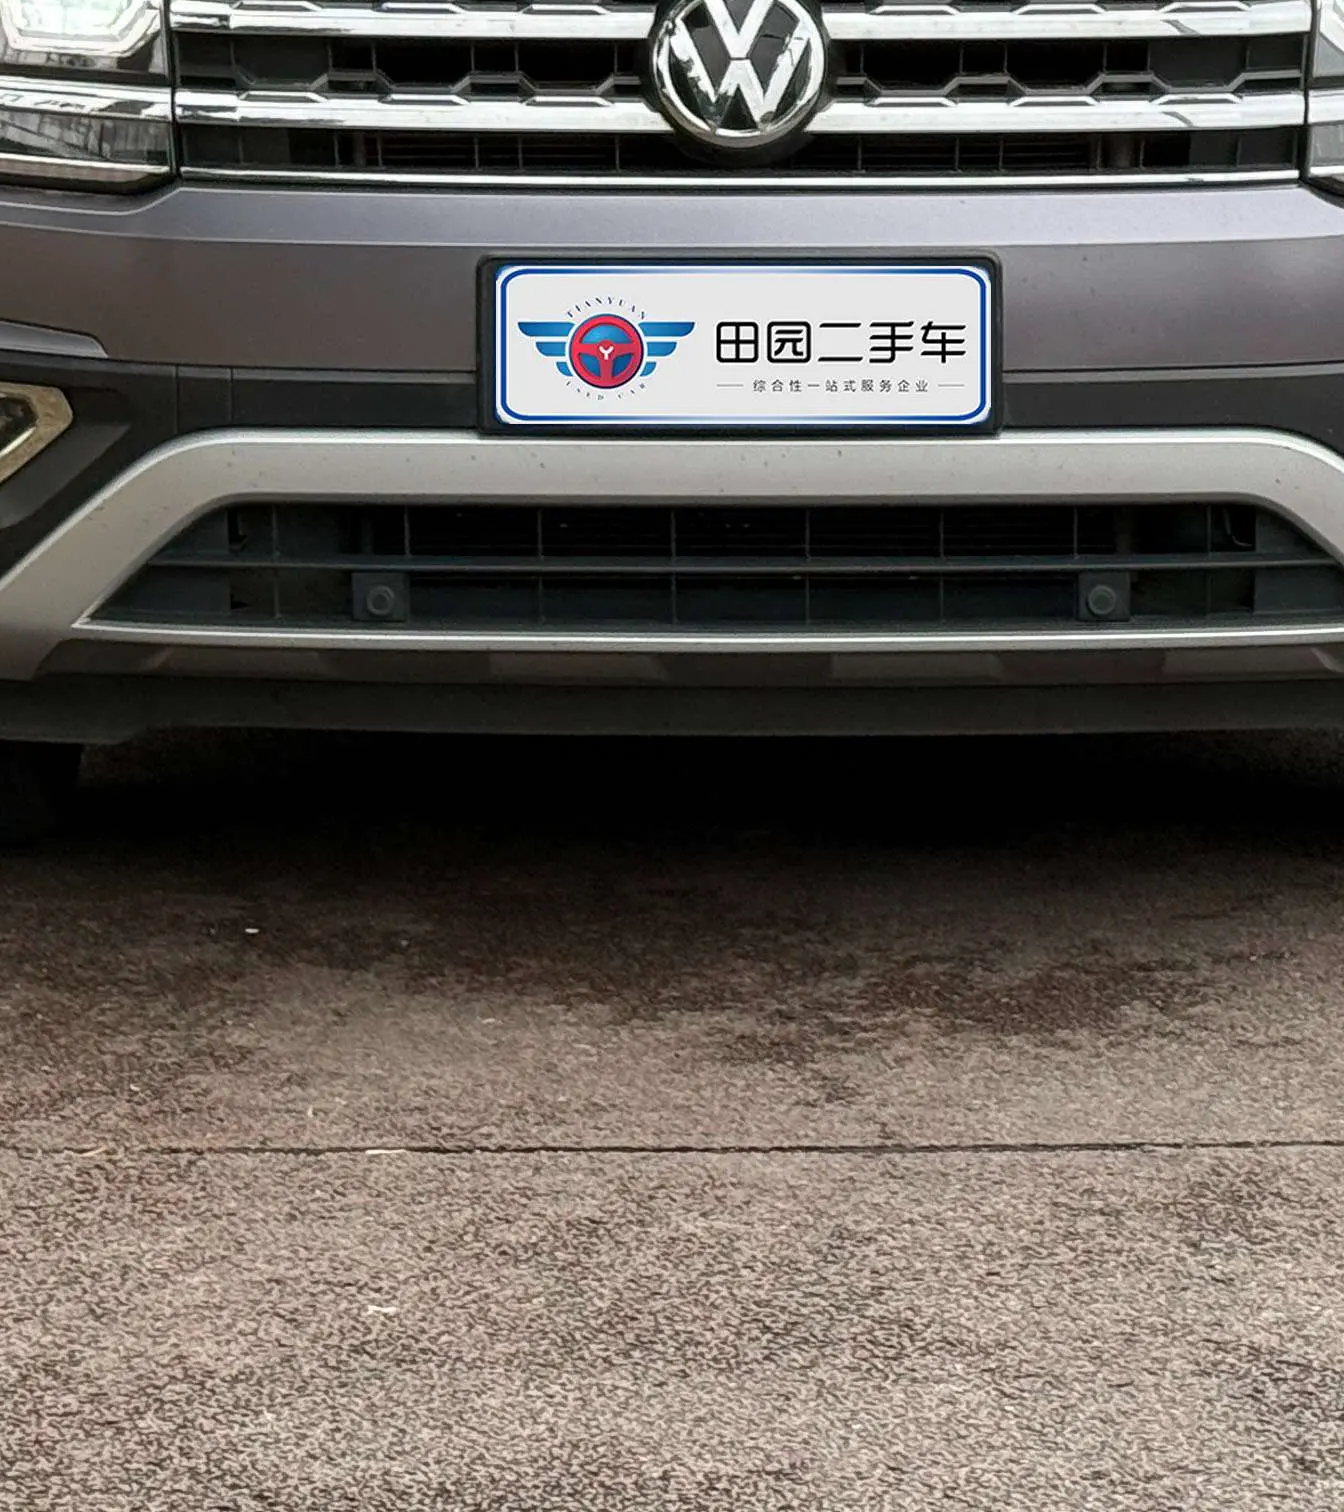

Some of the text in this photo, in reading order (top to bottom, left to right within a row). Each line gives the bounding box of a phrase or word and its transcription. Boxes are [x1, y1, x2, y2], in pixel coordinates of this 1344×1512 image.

[716, 321, 966, 364] 田园二手车
[752, 378, 930, 393] 综合性一站式服务企业
